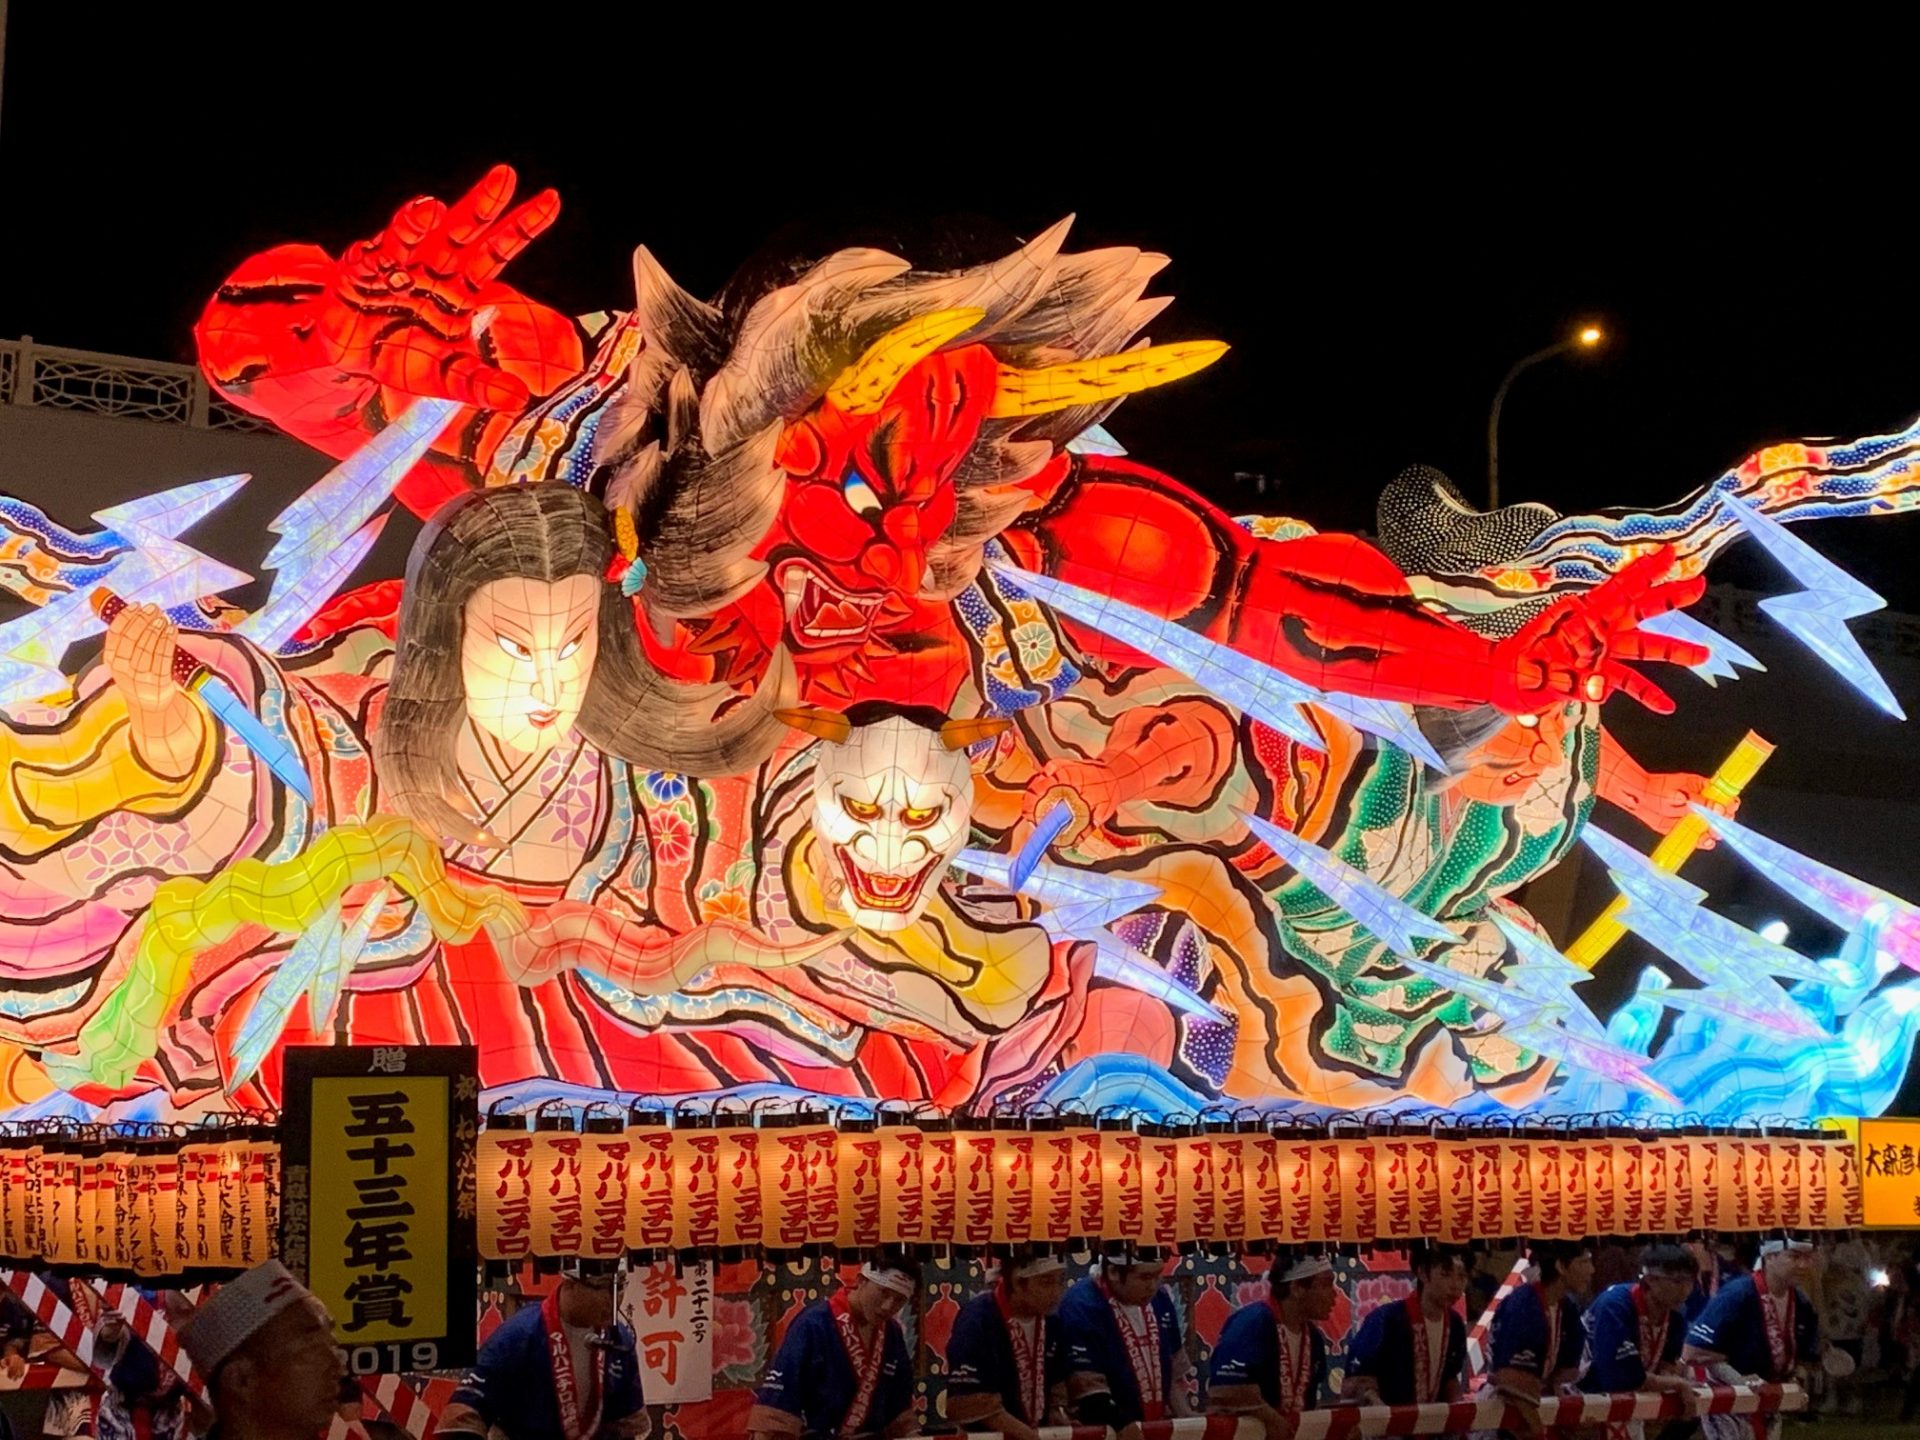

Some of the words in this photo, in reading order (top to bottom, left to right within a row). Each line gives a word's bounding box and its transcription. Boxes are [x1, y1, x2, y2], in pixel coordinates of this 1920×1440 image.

[367, 1046, 407, 1073] 贈
[454, 1074, 476, 1101] 祝
[342, 1090, 416, 1333] 五十三年賞
[456, 1115, 477, 1219] ねぶた祭
[495, 1137, 533, 1254] マルハニチロ
[547, 1137, 582, 1251] マルハニチロ
[592, 1142, 630, 1254] マルハニチロ
[638, 1132, 674, 1245] マルハニチロ
[687, 1136, 719, 1245] マルハニチロ
[729, 1133, 763, 1240] マルハニチロ
[777, 1135, 808, 1243] マルハニチロ
[807, 1130, 839, 1238] マルハニチロ
[852, 1141, 881, 1244] マルハニチロ
[896, 1132, 923, 1238] マルハニチロ
[929, 1139, 956, 1240] マルハニチロ
[966, 1137, 995, 1242] マルハニチロ
[1006, 1137, 1033, 1239] マルハニチロ
[1047, 1137, 1072, 1239] マルハニチロ
[1077, 1133, 1103, 1231] マルハニチロ
[1115, 1136, 1143, 1235] マルハニチロ
[1153, 1144, 1178, 1243] マルハニチロ
[1189, 1141, 1215, 1237] マルハニチロ
[1218, 1139, 1245, 1237] マルハニチロ
[1252, 1138, 1283, 1235] マルハニチロ
[1865, 1142, 1920, 1178] 大森彦
[641, 1261, 687, 1386] 許可
